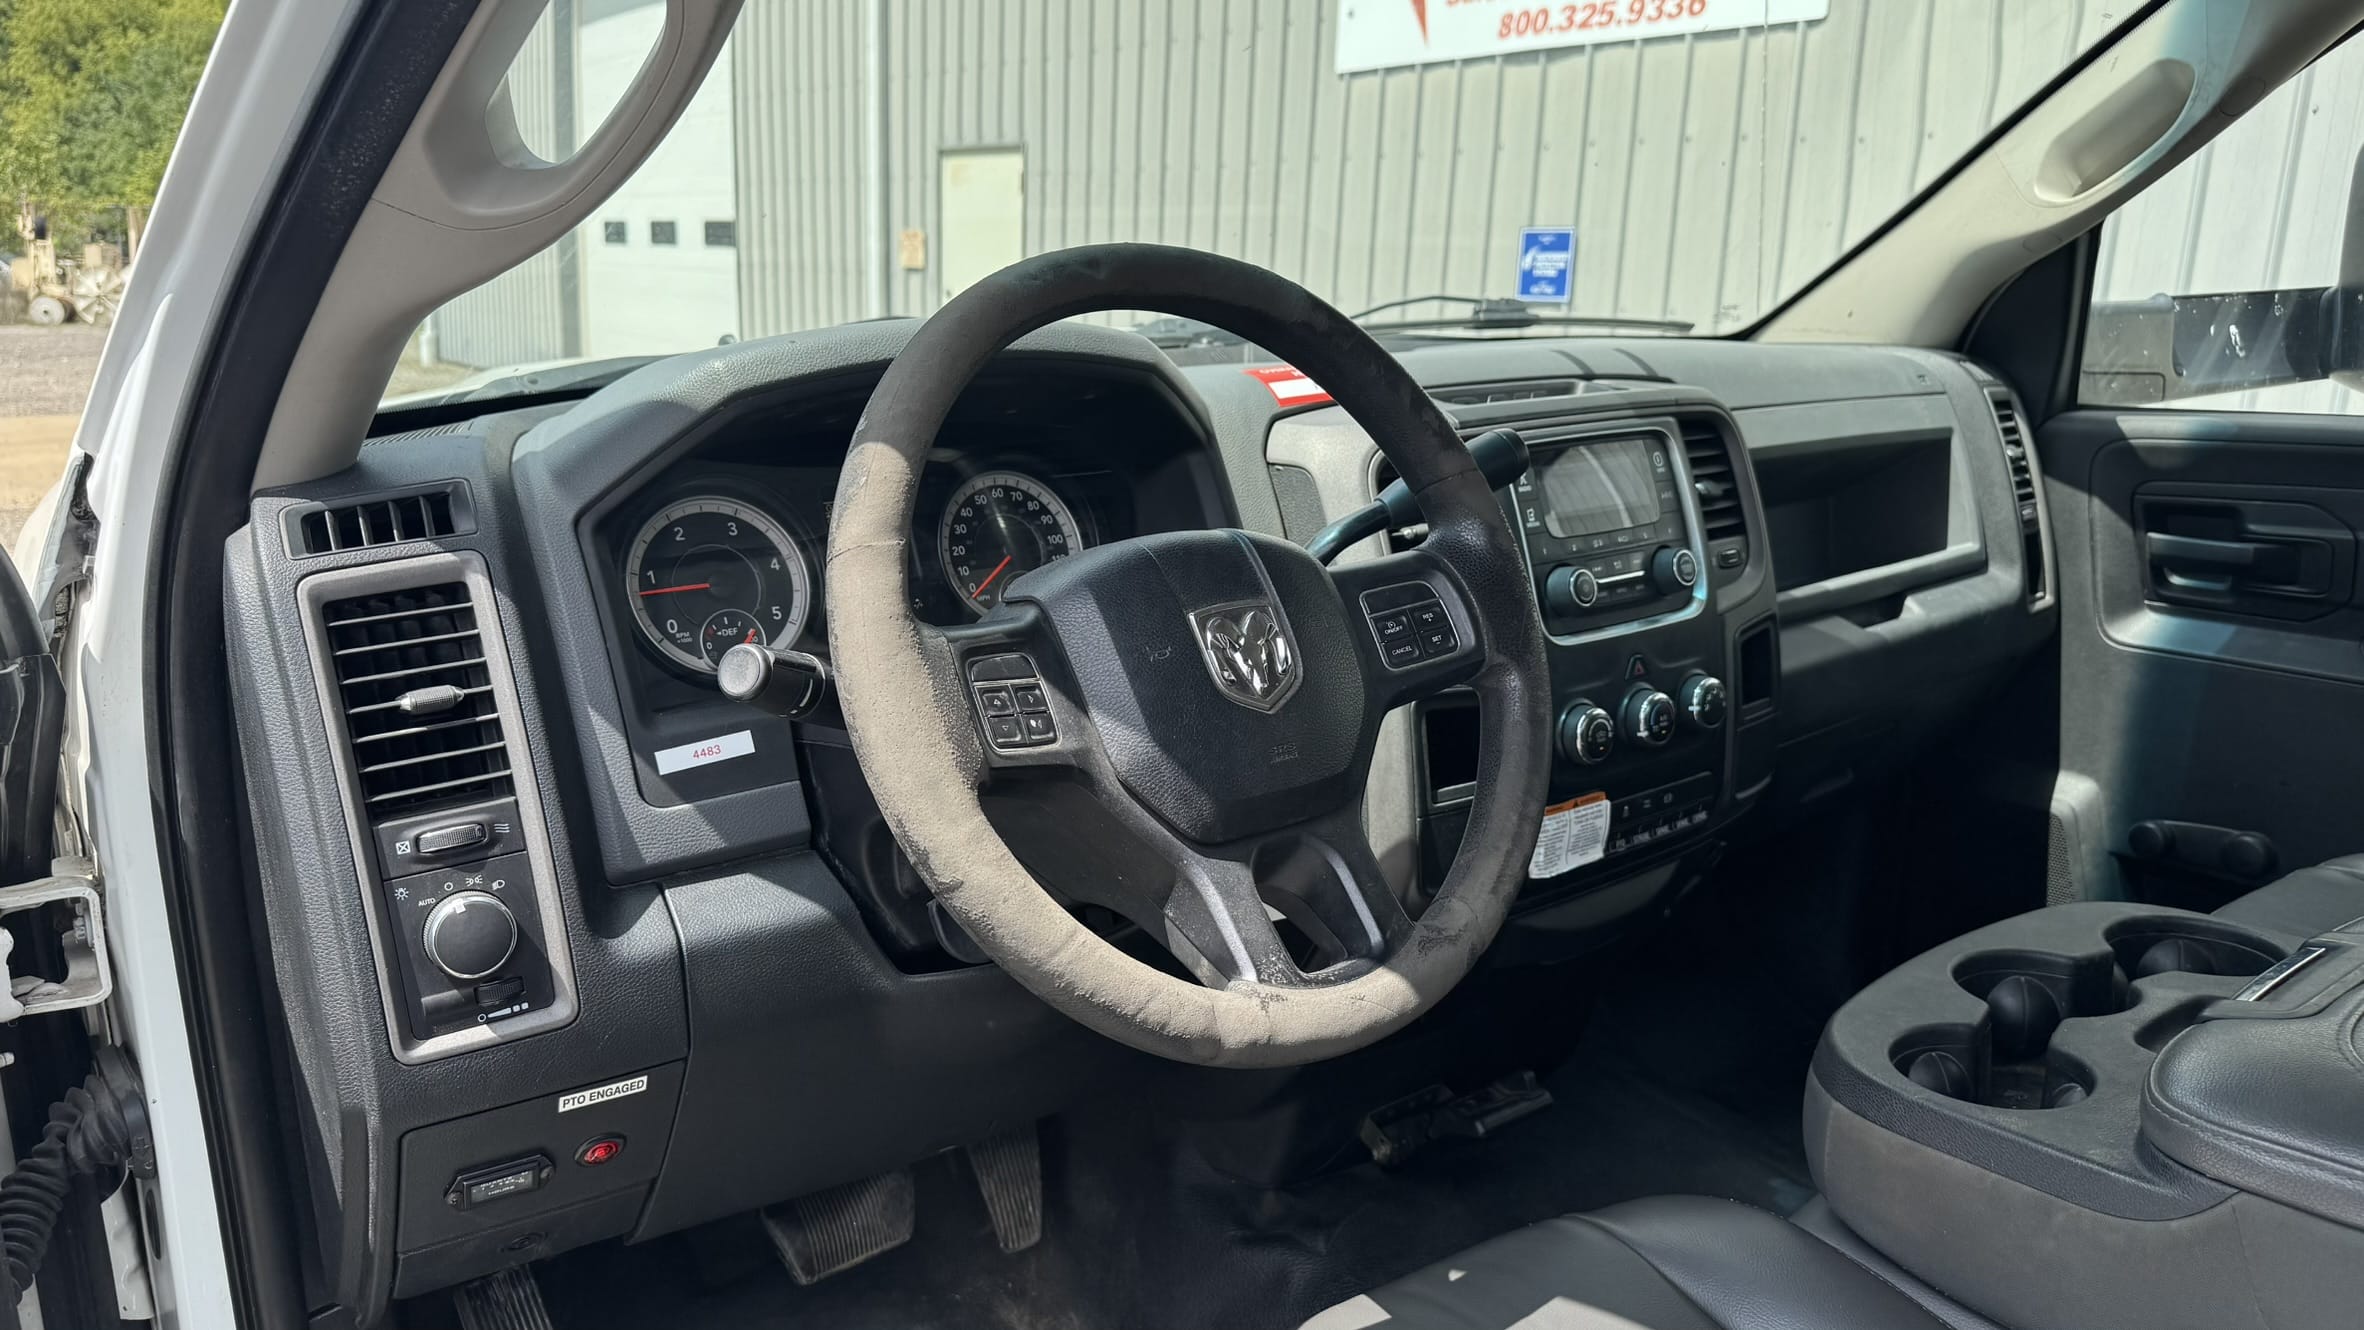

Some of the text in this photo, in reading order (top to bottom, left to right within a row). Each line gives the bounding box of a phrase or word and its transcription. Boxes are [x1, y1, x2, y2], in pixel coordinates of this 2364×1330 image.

[991, 488, 1004, 498] 60
[1010, 491, 1023, 501] 70
[974, 494, 987, 505] 50
[1027, 500, 1040, 511] 80
[960, 507, 973, 517] 40
[1041, 514, 1053, 525] 90
[674, 527, 686, 541] 2
[727, 522, 738, 536] 3
[954, 524, 967, 535] 30
[1047, 533, 1063, 545] 100
[952, 545, 965, 556] 20
[770, 557, 781, 571] 4
[958, 566, 969, 576] 10
[646, 570, 656, 584] 1
[969, 582, 976, 592] 0
[771, 606, 782, 620] 5
[667, 619, 678, 634] 0
[721, 627, 739, 636] DEF
[675, 631, 690, 639] RPM
[1392, 645, 1413, 655] CANCEL
[693, 744, 722, 759] 4483
[418, 897, 436, 907] AUTO
[562, 1079, 645, 1109] PTO ENGAGED
